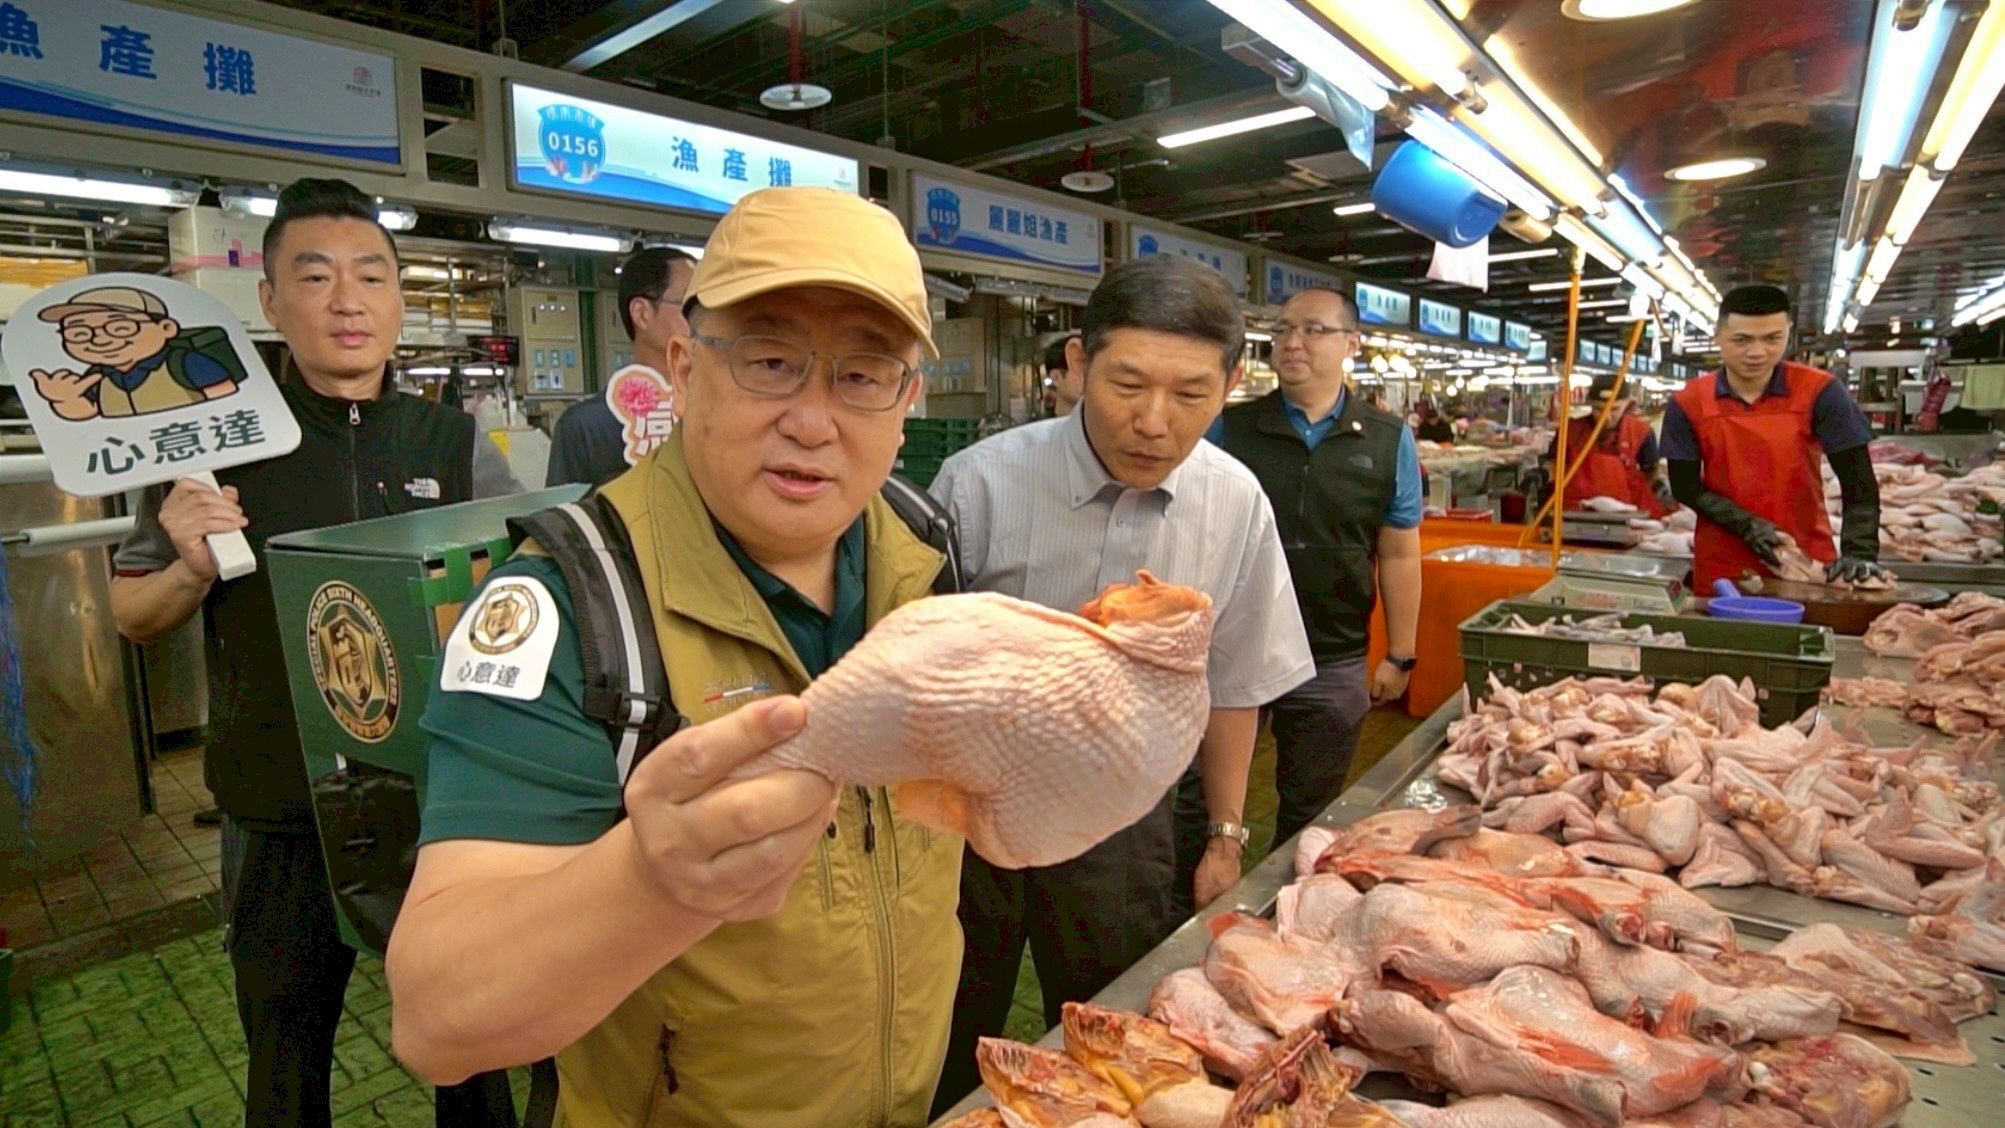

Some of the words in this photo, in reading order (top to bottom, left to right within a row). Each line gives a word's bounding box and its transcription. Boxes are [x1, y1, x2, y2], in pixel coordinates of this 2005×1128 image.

[548, 131, 599, 158] 0156
[87, 409, 266, 475] 心意達
[456, 660, 521, 689] 心意達
